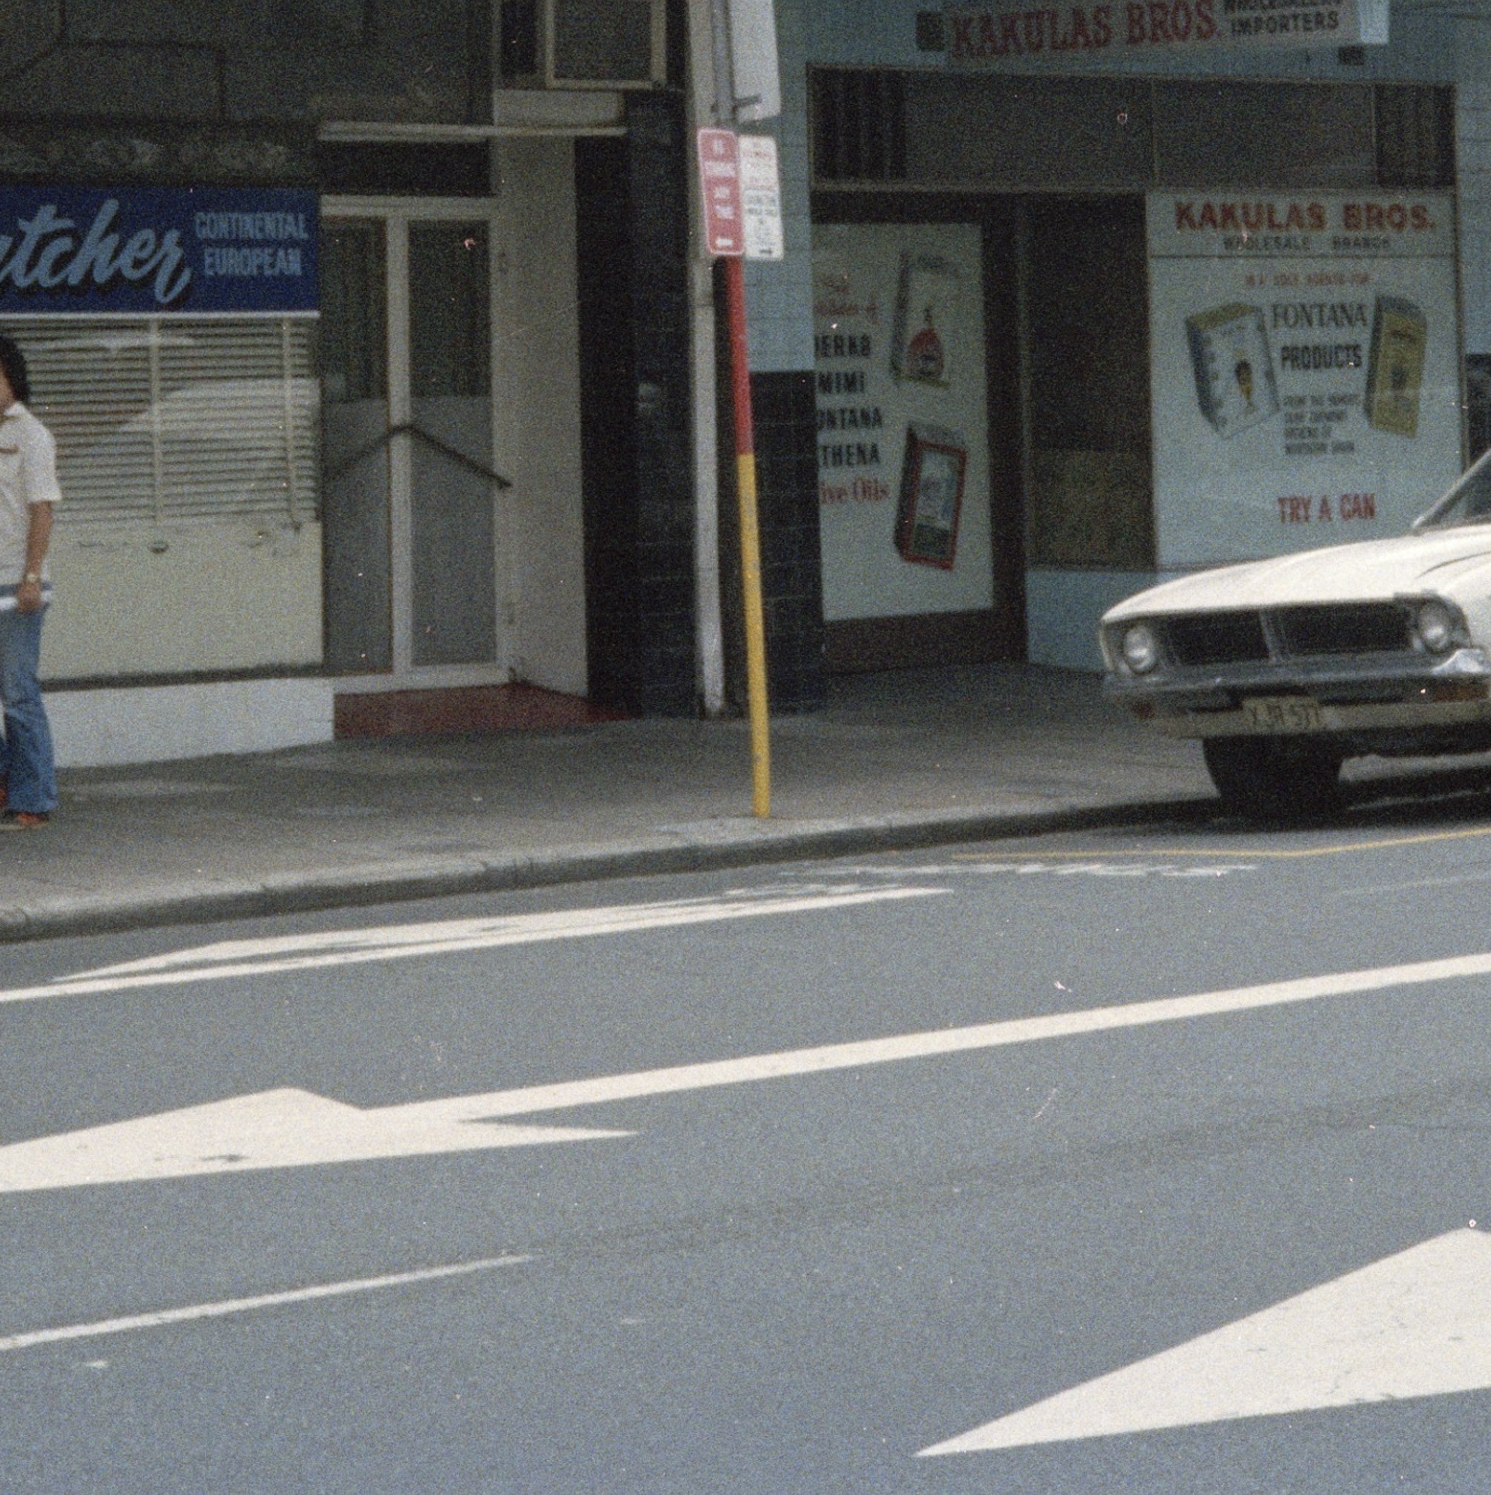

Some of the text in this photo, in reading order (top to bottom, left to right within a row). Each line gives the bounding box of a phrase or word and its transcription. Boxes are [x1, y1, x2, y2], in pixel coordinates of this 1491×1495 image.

[950, 2, 1113, 59] KAKULAS
[1230, 10, 1340, 36] IMPORTERS
[194, 210, 309, 240] CONTINENTAL
[1175, 200, 1436, 233] KAKULAS BROS.
[203, 246, 303, 277] EUROPEAN
[1271, 302, 1368, 330] FONTANA
[1280, 343, 1362, 370] PRODUCTS
[1277, 493, 1376, 524] TRY A CAN
